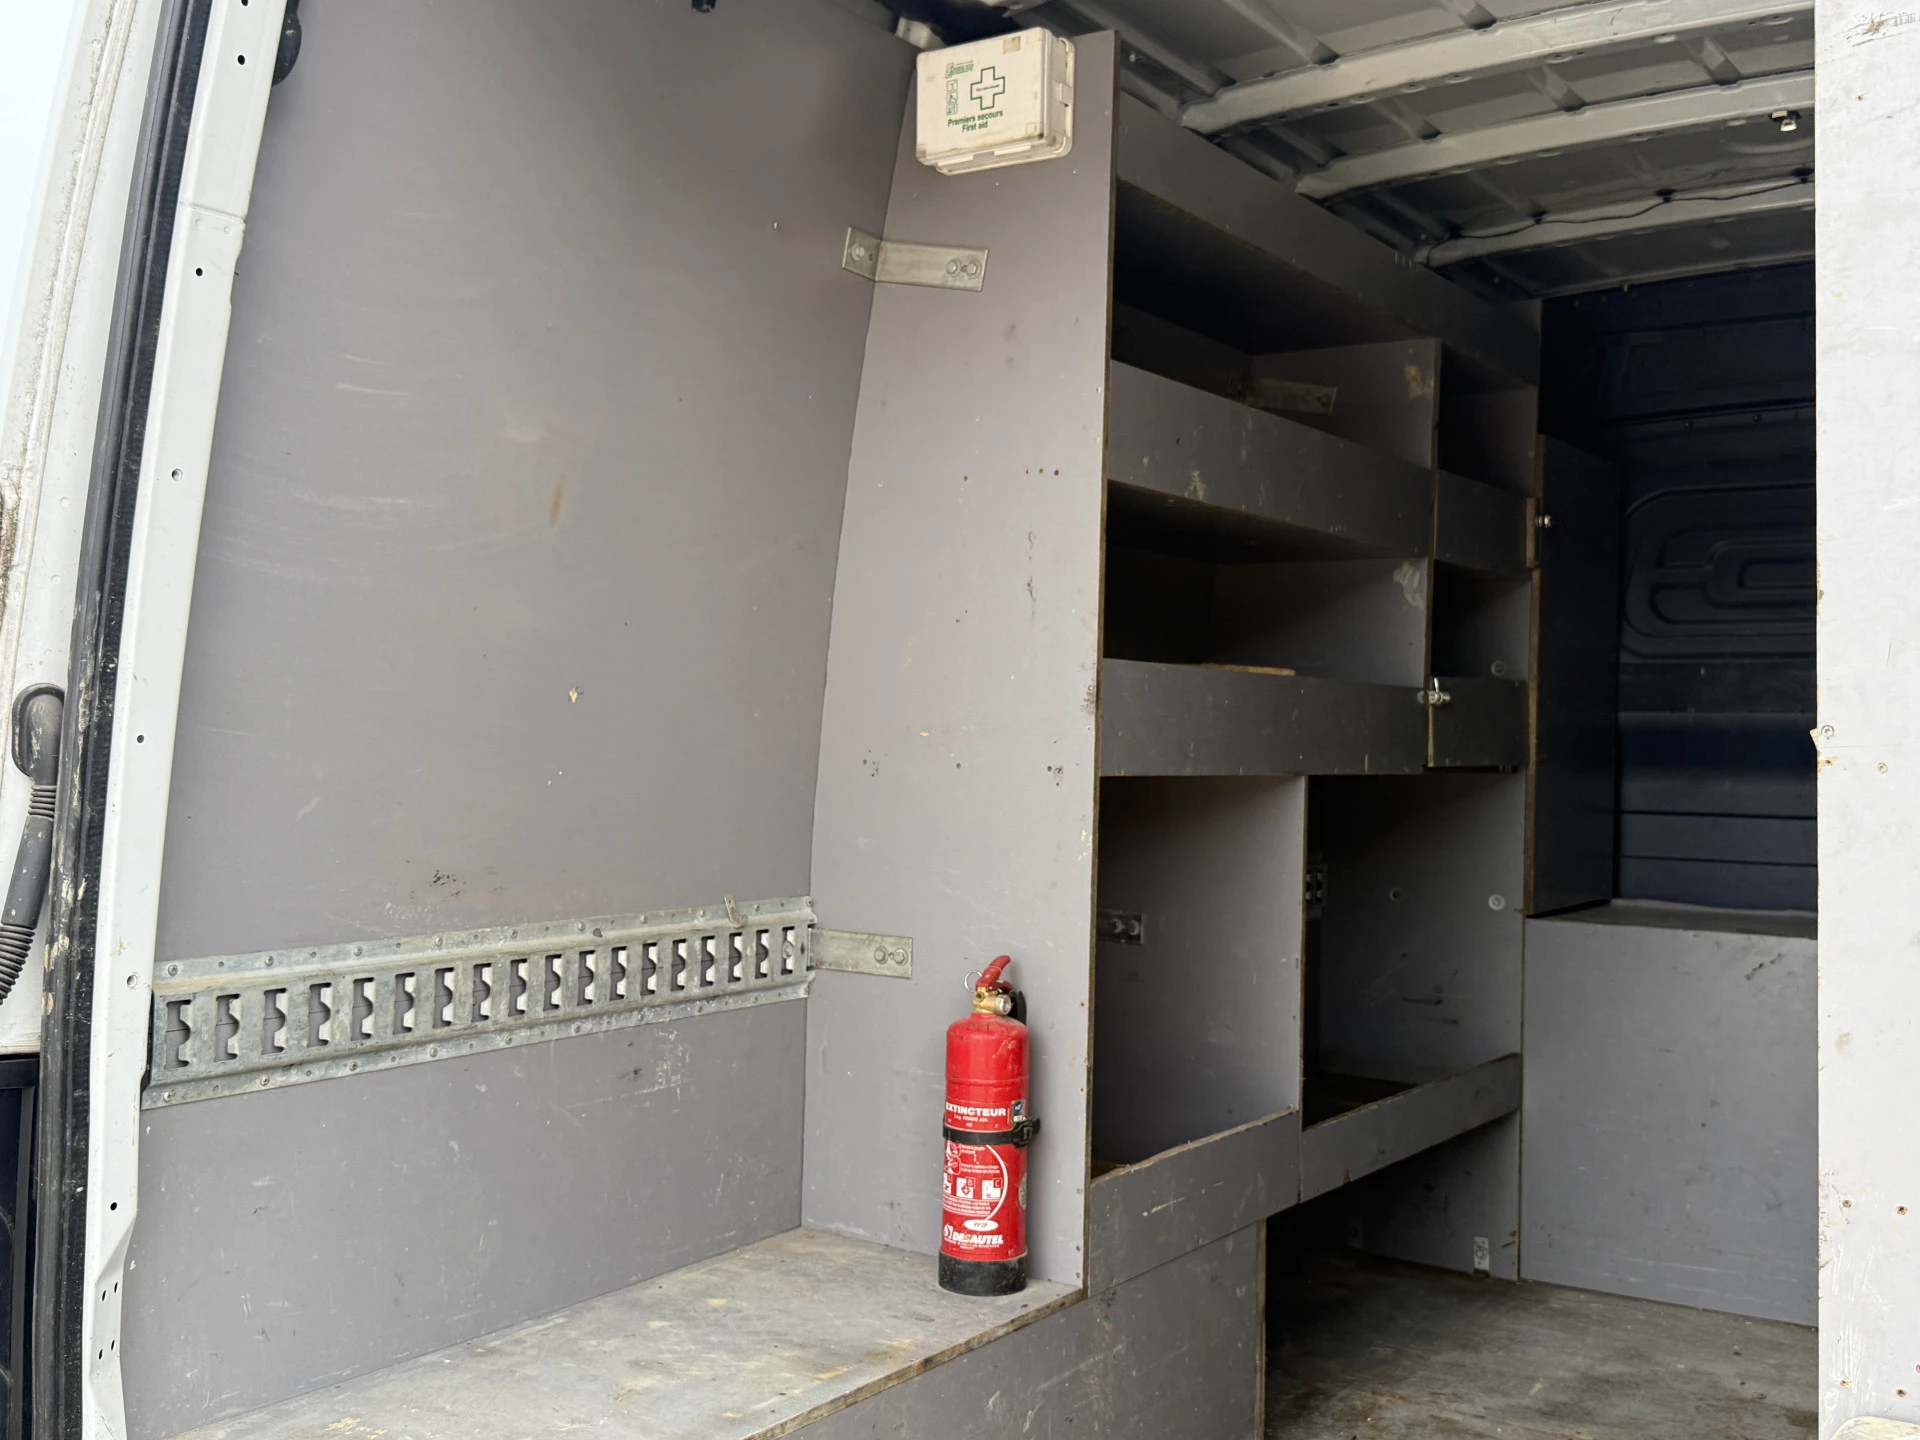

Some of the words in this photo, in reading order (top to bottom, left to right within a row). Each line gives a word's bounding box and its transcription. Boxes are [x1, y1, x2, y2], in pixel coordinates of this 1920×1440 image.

[948, 116, 976, 127] Premiers
[977, 111, 1003, 121] secours
[962, 123, 977, 132] First
[978, 121, 988, 129] aid
